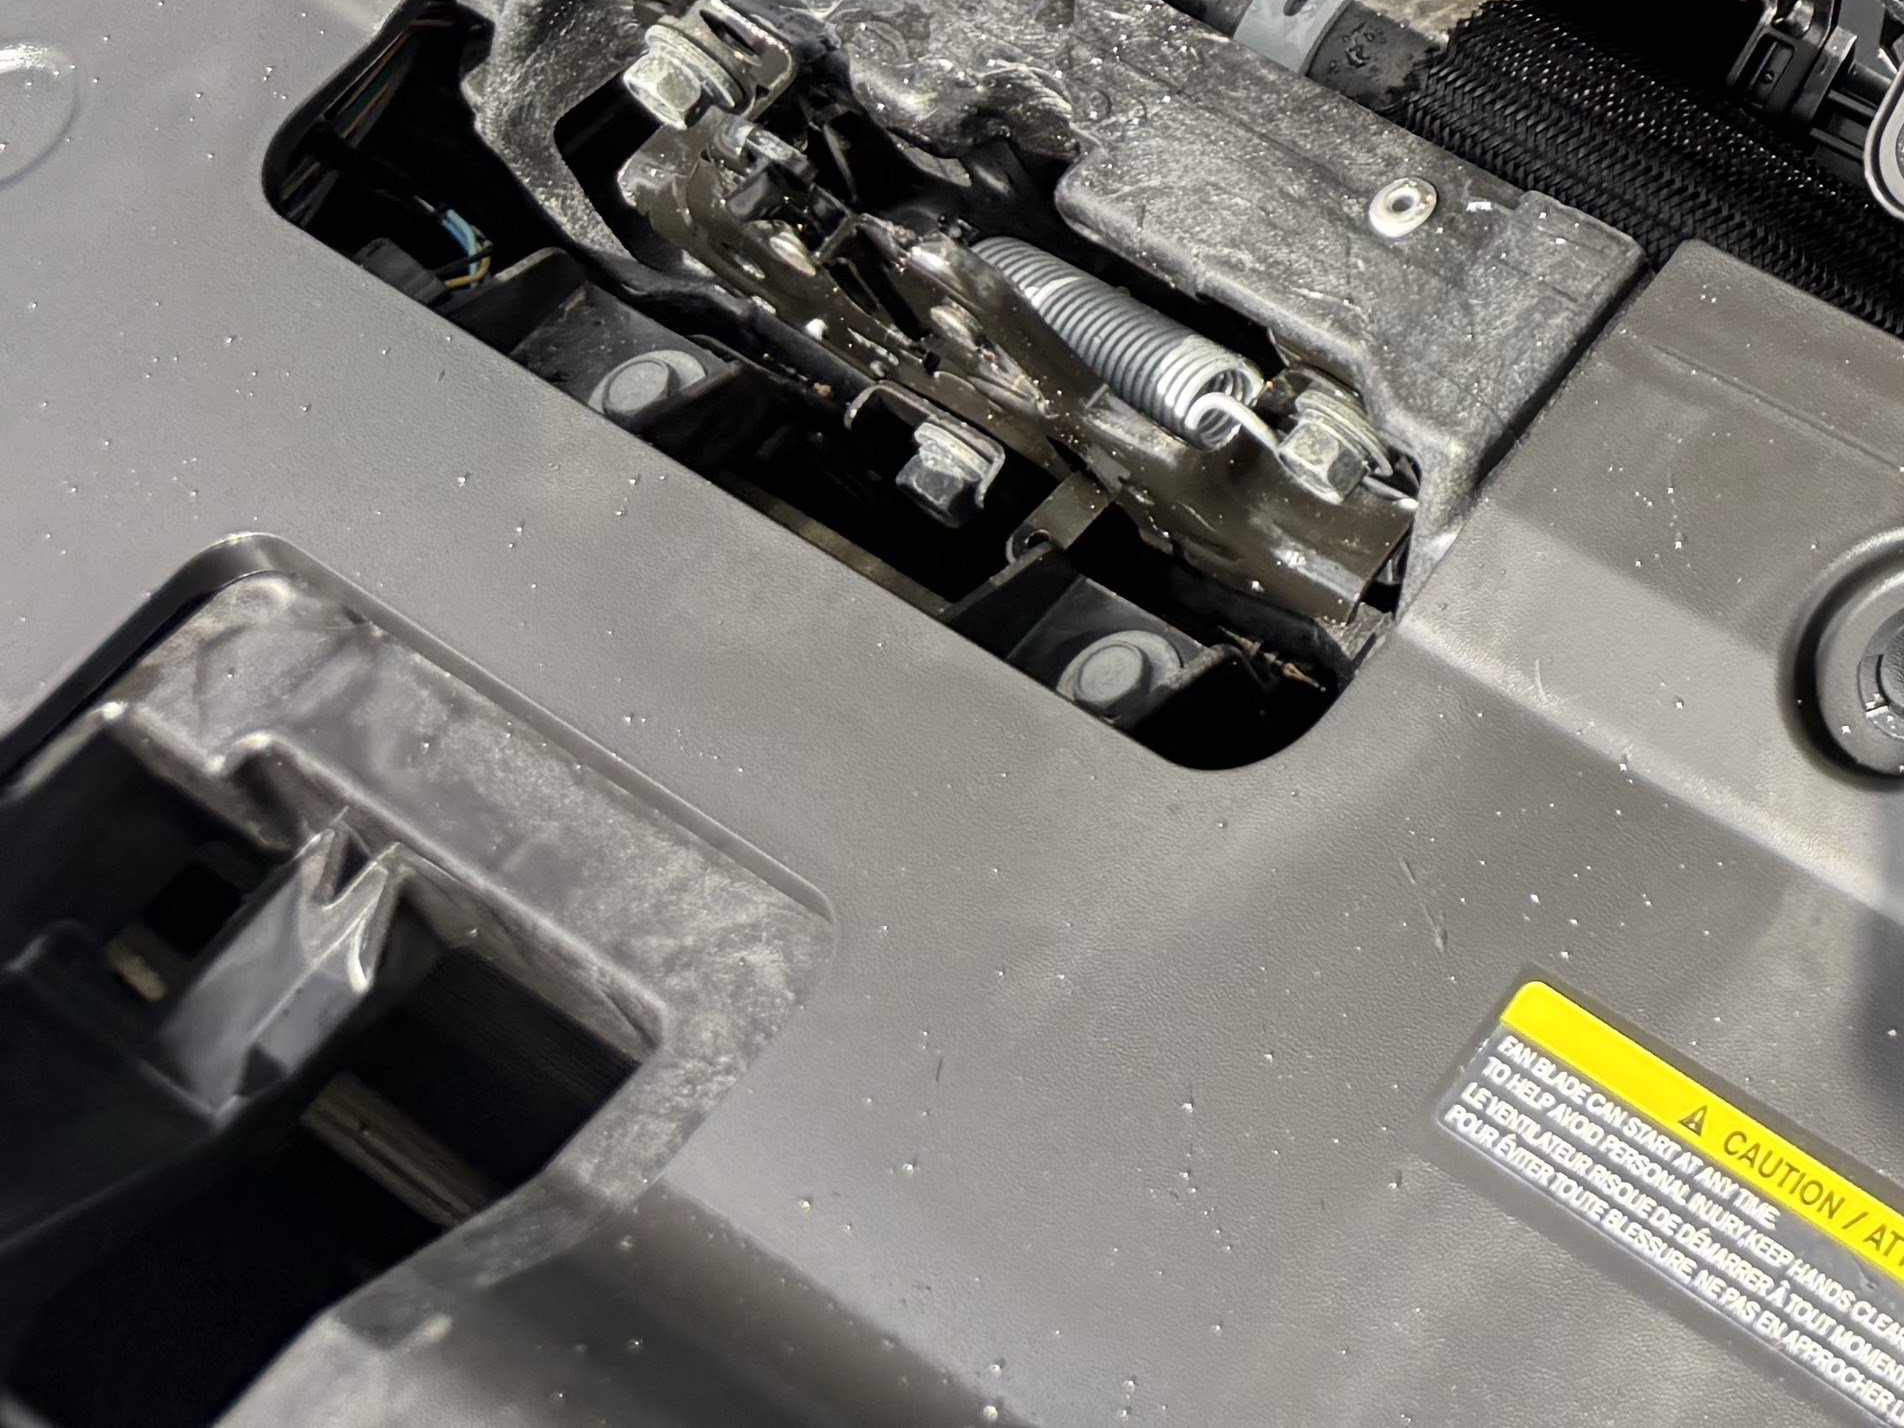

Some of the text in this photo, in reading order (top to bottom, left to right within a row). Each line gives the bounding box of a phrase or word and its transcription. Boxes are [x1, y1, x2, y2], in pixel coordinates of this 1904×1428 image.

[1459, 1079, 1495, 1113] LE
[1482, 1095, 1596, 1178] VENTILATEUR
[1584, 1161, 1660, 1220] RISQUE
[1647, 1201, 1686, 1237] DE
[1673, 1216, 1779, 1297] DÉMARRER
[1779, 1291, 1838, 1340] TOUT
[1478, 1054, 1514, 1087] TO
[1503, 1070, 1558, 1115] HELP
[1545, 1098, 1608, 1148] AVOID
[1595, 1132, 1697, 1207] PERSONAL
[1784, 1256, 1860, 1314] HANDS
[1495, 1032, 1540, 1071] FAN
[1528, 1054, 1594, 1106] BLADE
[1582, 1089, 1629, 1130] CAN
[1619, 1114, 1682, 1164] START
[1670, 1147, 1705, 1179] AT
[1692, 1161, 1741, 1203] ANY
[1716, 1124, 1848, 1223] CAUTION
[1841, 1205, 1870, 1237] /
[1441, 1101, 1501, 1150] POUR
[1492, 1130, 1561, 1186] ÉVITER
[1545, 1169, 1612, 1222] TOUTE
[1688, 1266, 1727, 1302] NE
[1716, 1284, 1764, 1325] PAS
[1753, 1308, 1789, 1342] EN
[1776, 1325, 1900, 1414] APPROCHER
